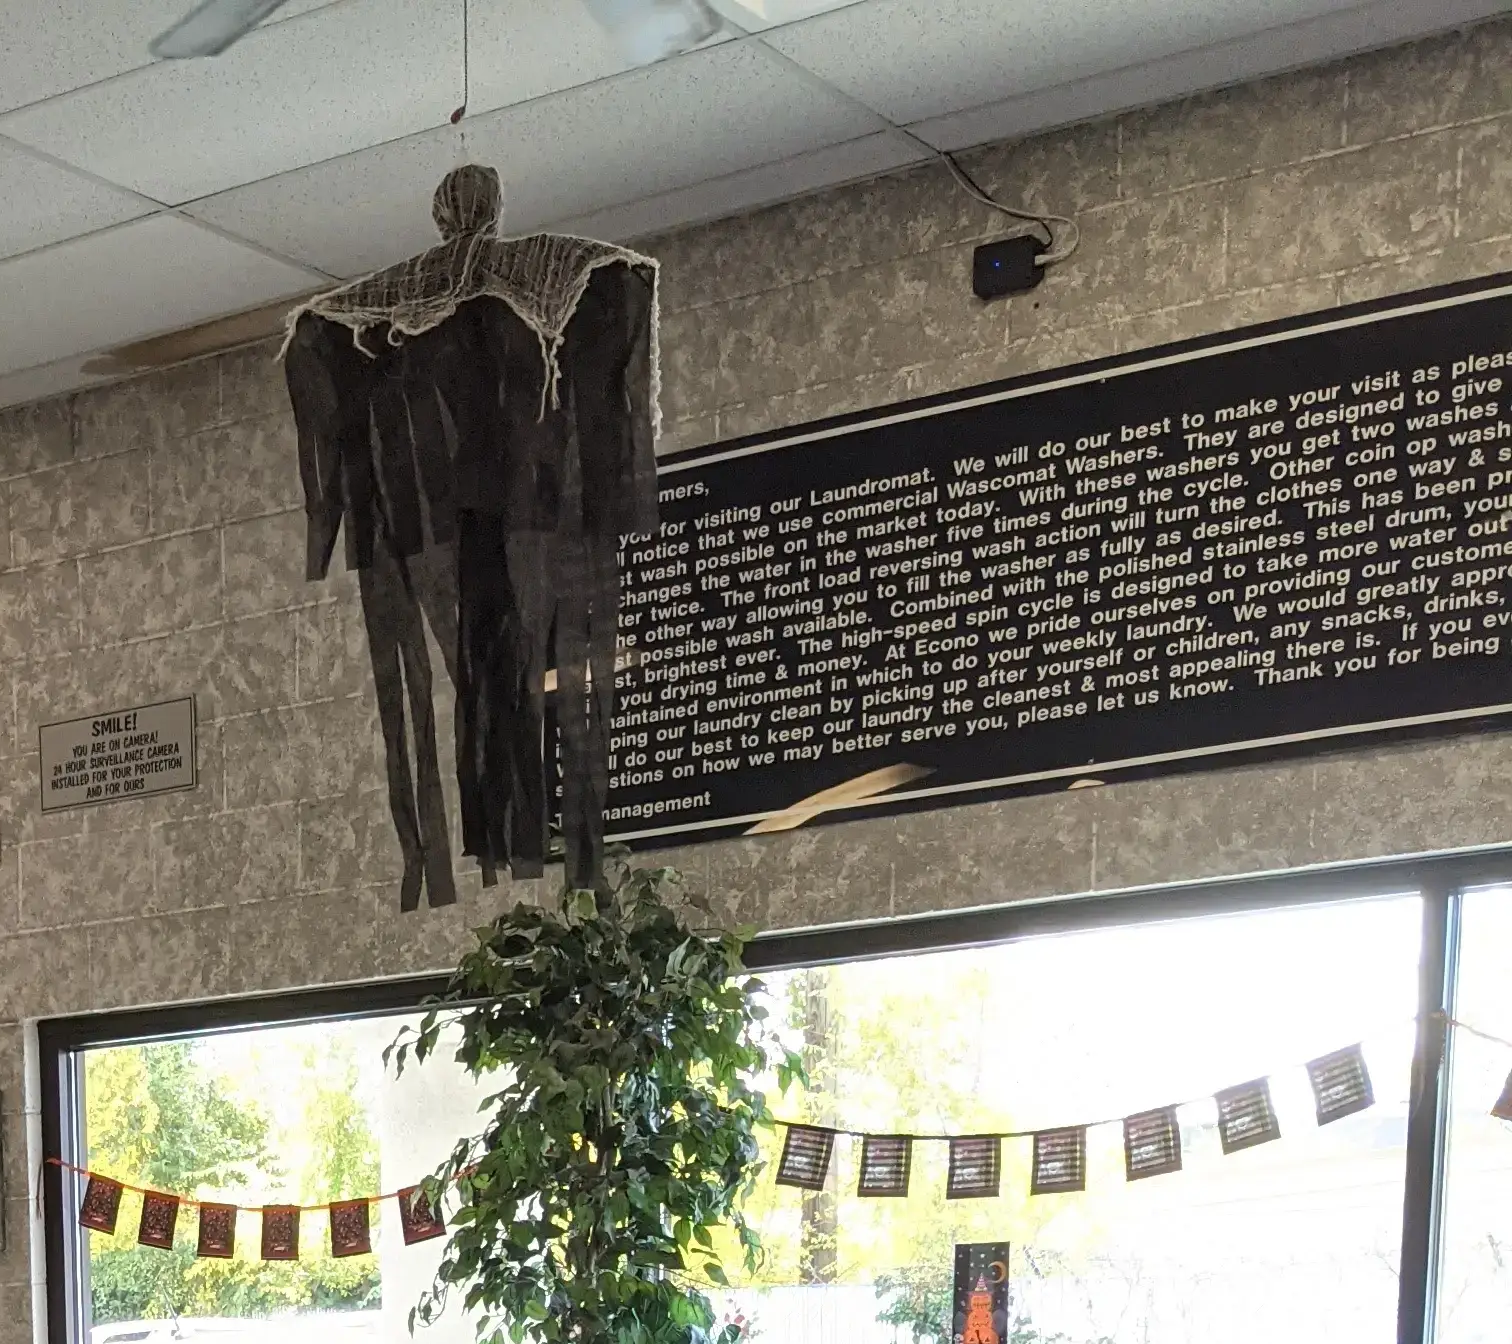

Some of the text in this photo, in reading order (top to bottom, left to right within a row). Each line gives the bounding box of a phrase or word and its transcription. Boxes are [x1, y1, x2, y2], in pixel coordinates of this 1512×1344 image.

[632, 377, 1502, 564] notice that we use commercial Wascomat Washers. They are designed to give
[640, 401, 1498, 582] wash possible on the market today. With these washers you get two washes
[659, 521, 686, 538] for
[694, 505, 761, 530] visiting
[769, 496, 802, 514] our
[810, 467, 935, 506] Laundromat.
[953, 456, 985, 476] We
[994, 445, 1028, 467] will
[1038, 440, 1065, 459] do
[1075, 432, 1111, 451] our
[1120, 417, 1171, 442] best
[1181, 413, 1204, 429] to
[1214, 398, 1278, 423] make
[1288, 385, 1341, 412] your
[1351, 370, 1400, 395] visit
[1411, 365, 1440, 383] as
[700, 574, 730, 591] the
[738, 562, 792, 583] water
[800, 555, 816, 572] in
[825, 549, 857, 566] the
[865, 533, 938, 558] washer
[946, 524, 984, 543] five
[993, 511, 1051, 533] times
[1061, 495, 1127, 520] during
[1137, 487, 1173, 505] the
[1183, 471, 1249, 498] cycle.
[1269, 455, 1335, 480] Other
[1345, 442, 1395, 466] coin
[1406, 437, 1437, 456] op
[644, 511, 1508, 683] brightest ever. The high-speed spin cycle is designed to take more water out
[650, 447, 1485, 621] twice. The front load reversing wash action will turn the clothes one way &
[51, 756, 182, 790] INSTALLED FOR YOUR PROTECTION
[65, 759, 86, 774] HOUR
[90, 748, 144, 769] SURVEILLANCE
[147, 742, 180, 759] CAMERA
[72, 730, 159, 758] YOU ARE ON CAMERA!
[91, 712, 138, 737] SMILE!
[671, 636, 1500, 778] on how we may better serve you, please let us know. Thank you for being
[86, 778, 145, 799] AND FOR OURS
